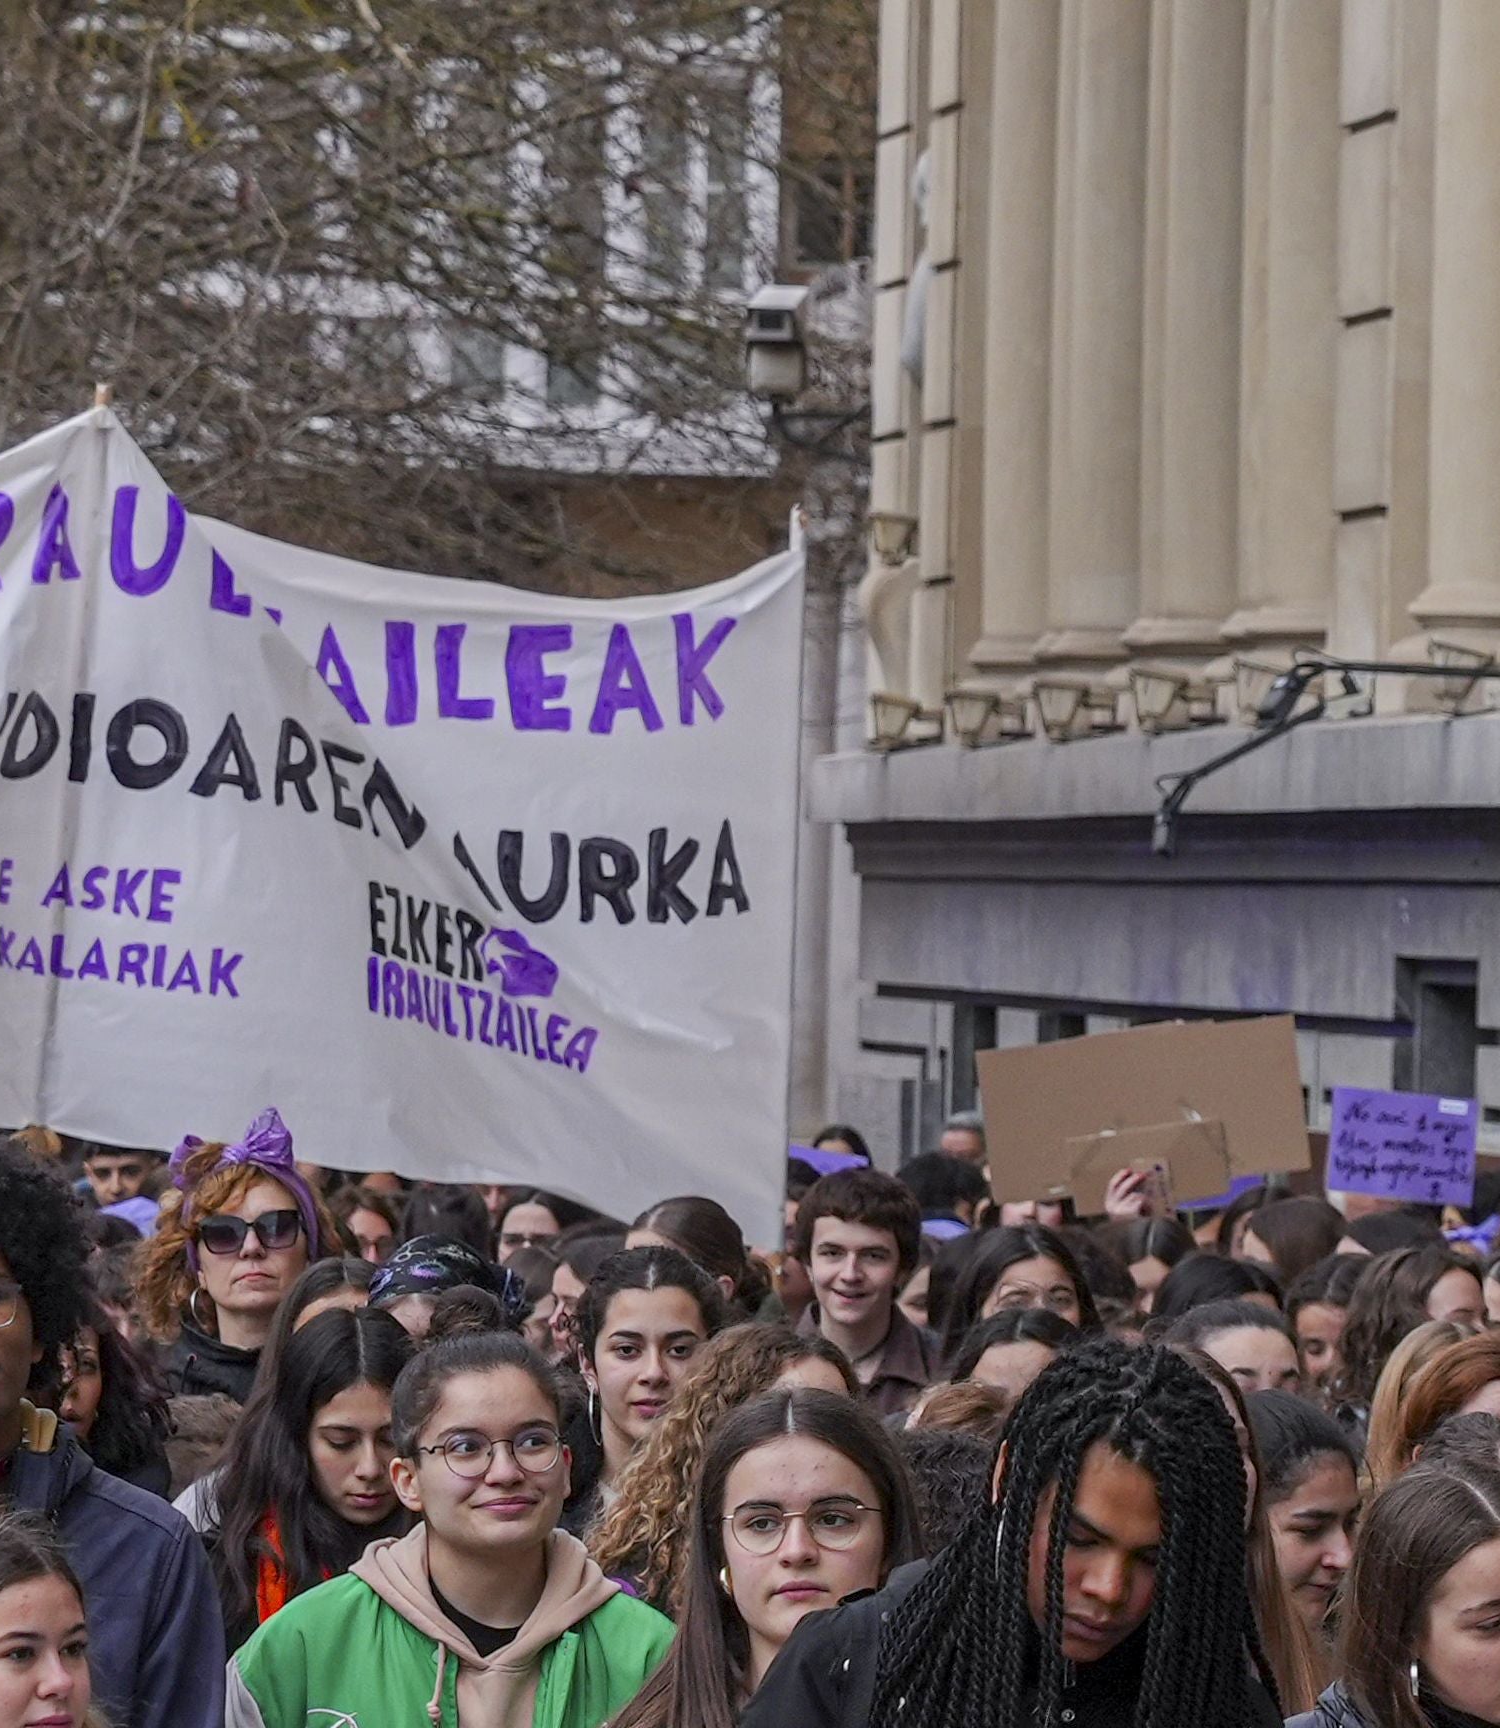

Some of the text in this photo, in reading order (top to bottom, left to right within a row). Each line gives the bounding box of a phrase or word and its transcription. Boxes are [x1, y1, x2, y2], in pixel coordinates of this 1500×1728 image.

[41, 860, 183, 924] ASKE
[368, 880, 486, 982] EZKER
[367, 956, 599, 1074] IRAULTZAILEA
